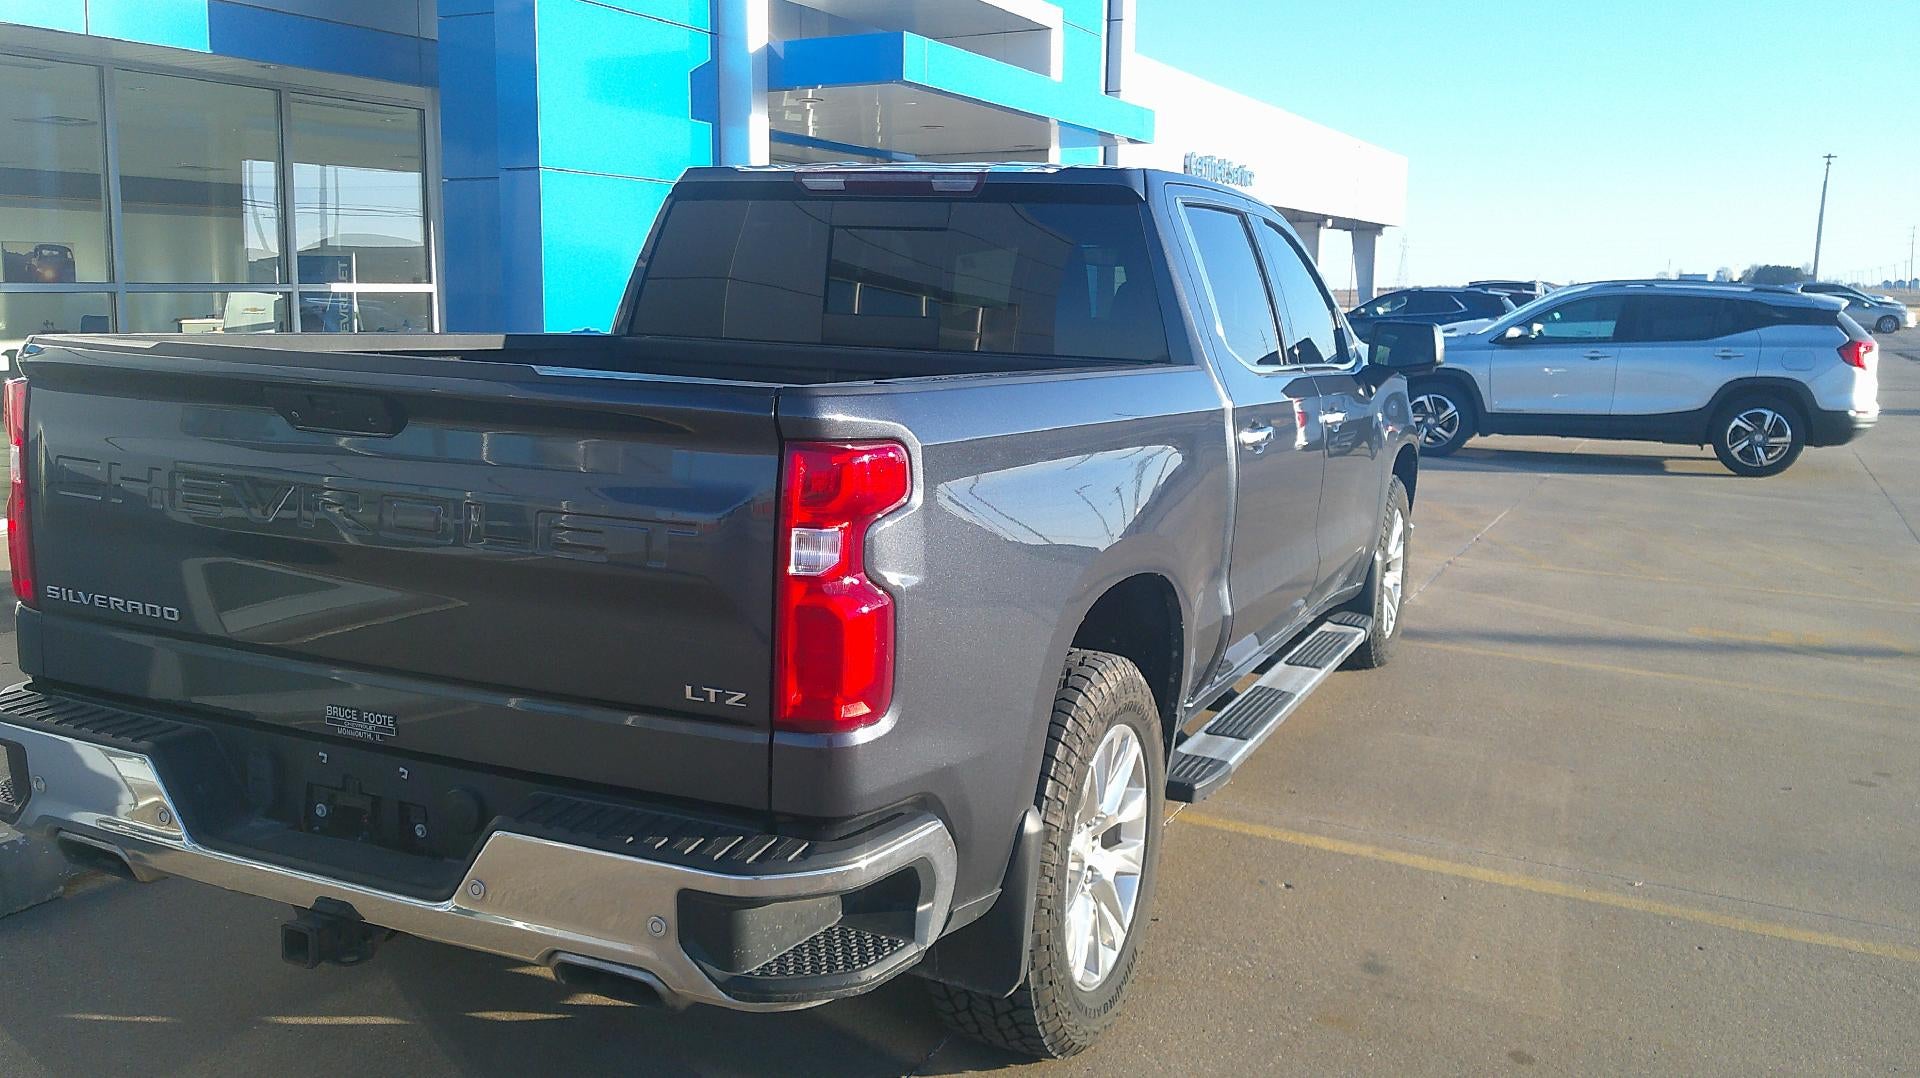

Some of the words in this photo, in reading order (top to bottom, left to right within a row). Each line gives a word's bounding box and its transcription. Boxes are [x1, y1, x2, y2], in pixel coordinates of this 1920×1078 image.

[55, 454, 700, 568] CHEVROLET
[46, 585, 180, 621] SILVERADO
[685, 685, 747, 707] LTZ
[326, 705, 357, 720] BRUCE
[363, 712, 394, 726] FOOTE
